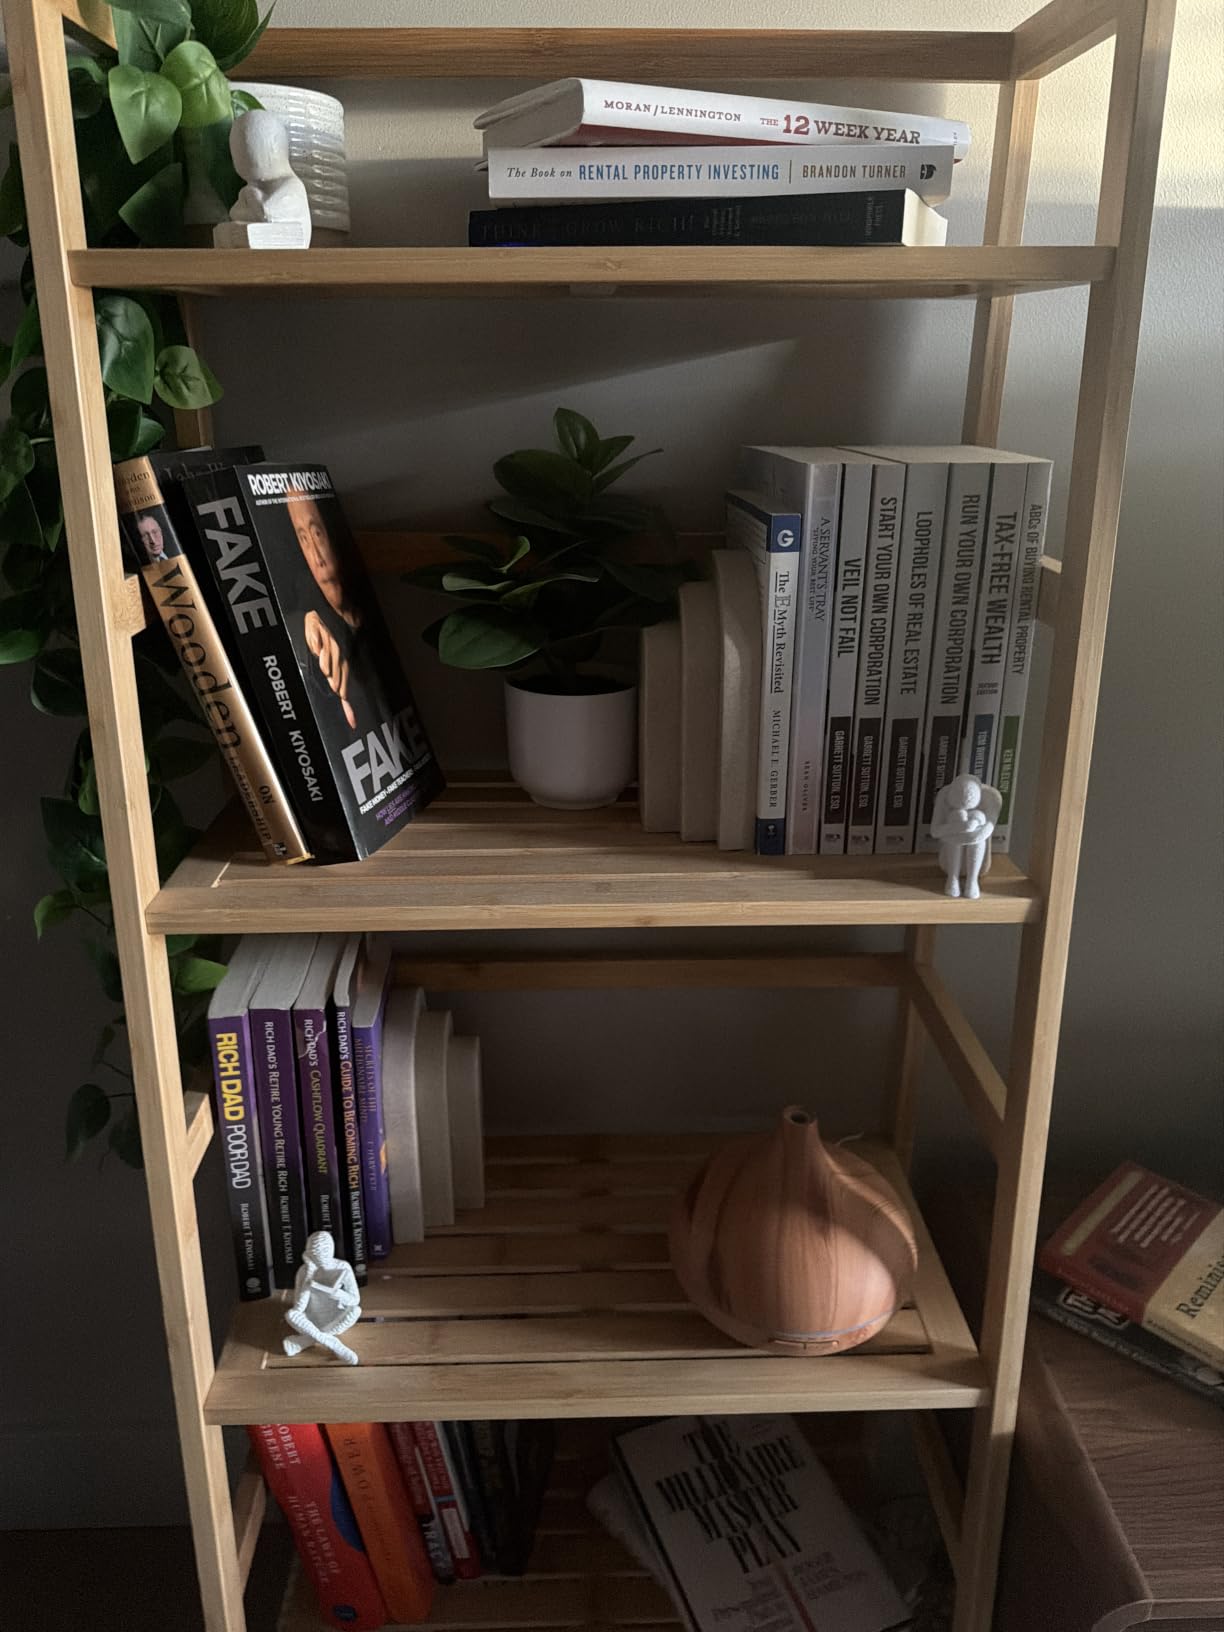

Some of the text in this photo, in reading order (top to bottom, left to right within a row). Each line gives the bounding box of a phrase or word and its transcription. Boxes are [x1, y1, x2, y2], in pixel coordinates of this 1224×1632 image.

[604, 100, 742, 122] MORAN/LENNINGTON
[760, 114, 921, 145] THE 12 WEEK YEAR
[507, 167, 526, 178] The
[530, 167, 556, 178] Book
[579, 164, 628, 180] RENTAL
[634, 164, 702, 180] PROPERTY
[708, 164, 779, 180] INVESTING
[802, 164, 906, 178] BRANDON TURNER
[247, 471, 333, 497] ROBERT KIYOSAKI
[778, 571, 790, 594] The
[814, 516, 831, 622] A SERVANT'S TRAY
[980, 511, 1017, 665] TAX-FREE WEALTH
[1012, 503, 1042, 675] ABCs OF BUYING RENTAL PROPERTY
[837, 558, 862, 658] VEIL NOT FAIL
[864, 497, 897, 706] START YOUR OWN CORPORATION
[900, 511, 933, 695] LOOPHOLES OF REAL ESTATE
[941, 494, 980, 705] RUN YOUR OWN CORPORATION
[774, 609, 788, 639] Myth
[152, 563, 242, 748] Wooden
[196, 495, 323, 803] FAKE ROBERT KIYOSAKI
[774, 642, 786, 694] Revisited
[771, 709, 781, 755] MICHAEL
[834, 730, 845, 763] GARRETT
[862, 736, 874, 765] GARRETT
[341, 706, 429, 806] FAKE
[259, 784, 275, 805] ON
[768, 769, 778, 808] GERBER
[216, 1032, 252, 1190] RICH DAD POOR DAD
[264, 1021, 289, 1192] RICH DAD'S RETIRE YOUNG RETIRE RICH
[303, 1019, 328, 1175] RICH DAD'S CASHFLOW QUADRANT
[336, 1011, 359, 1189] RICH DAD'S GUIDE TO BECOMING RICH
[240, 1203, 251, 1230] ROBERT
[280, 1195, 291, 1222] ROBERT
[320, 1194, 331, 1221] ROBERT
[350, 1190, 361, 1219] ROBERT
[244, 1239, 255, 1271] KIYOSAKI
[282, 1231, 294, 1264] KIYOSAKI
[353, 1228, 364, 1261] KIYOSAKI
[1176, 1254, 1224, 1319] Reminis
[277, 1424, 301, 1464] OBERT
[727, 1517, 802, 1574] PLAN
